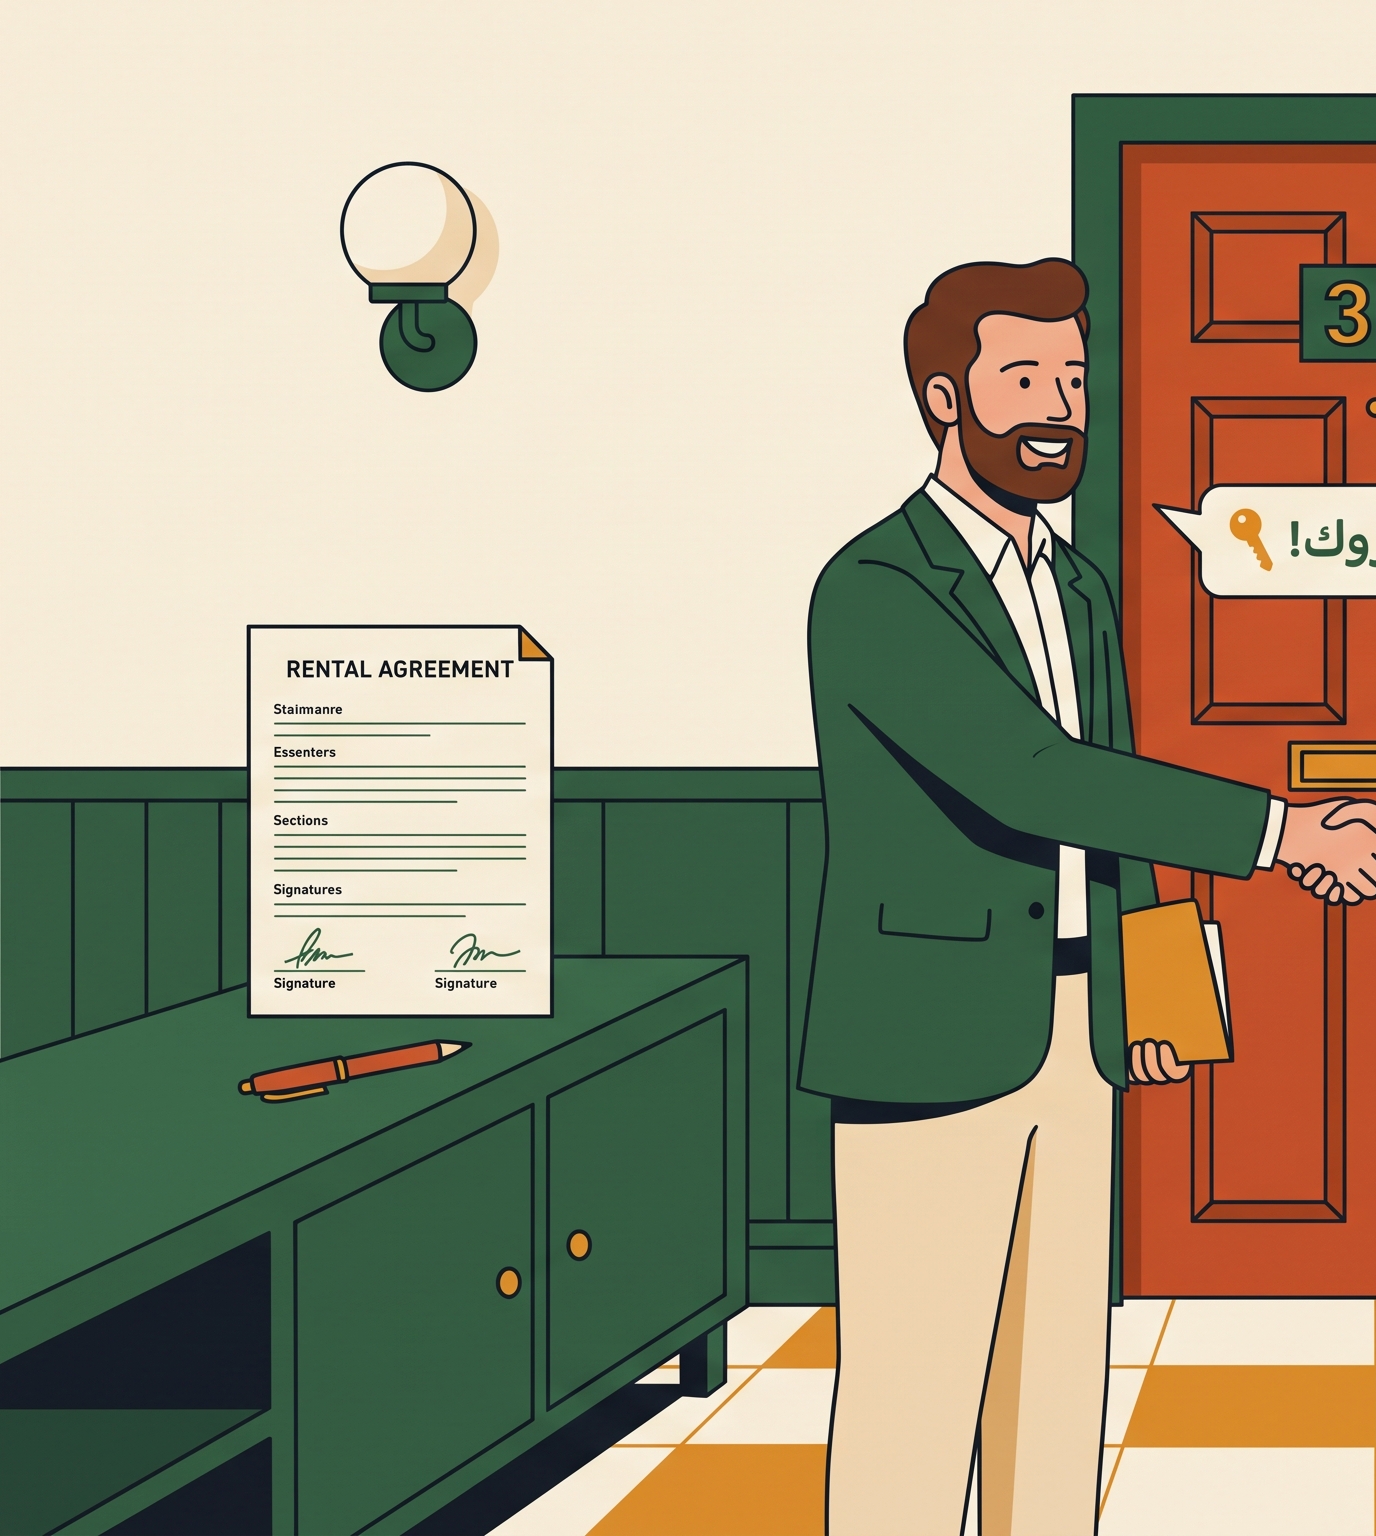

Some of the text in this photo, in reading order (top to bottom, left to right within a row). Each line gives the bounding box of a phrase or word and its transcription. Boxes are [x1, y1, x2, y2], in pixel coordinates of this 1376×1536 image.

[287, 660, 514, 678] RENTAL AGREEMENT
[273, 746, 336, 758] Essenters
[273, 814, 328, 826] Sections
[273, 884, 342, 897] Signatures
[273, 978, 336, 991] Signature
[435, 978, 497, 991] Signature
